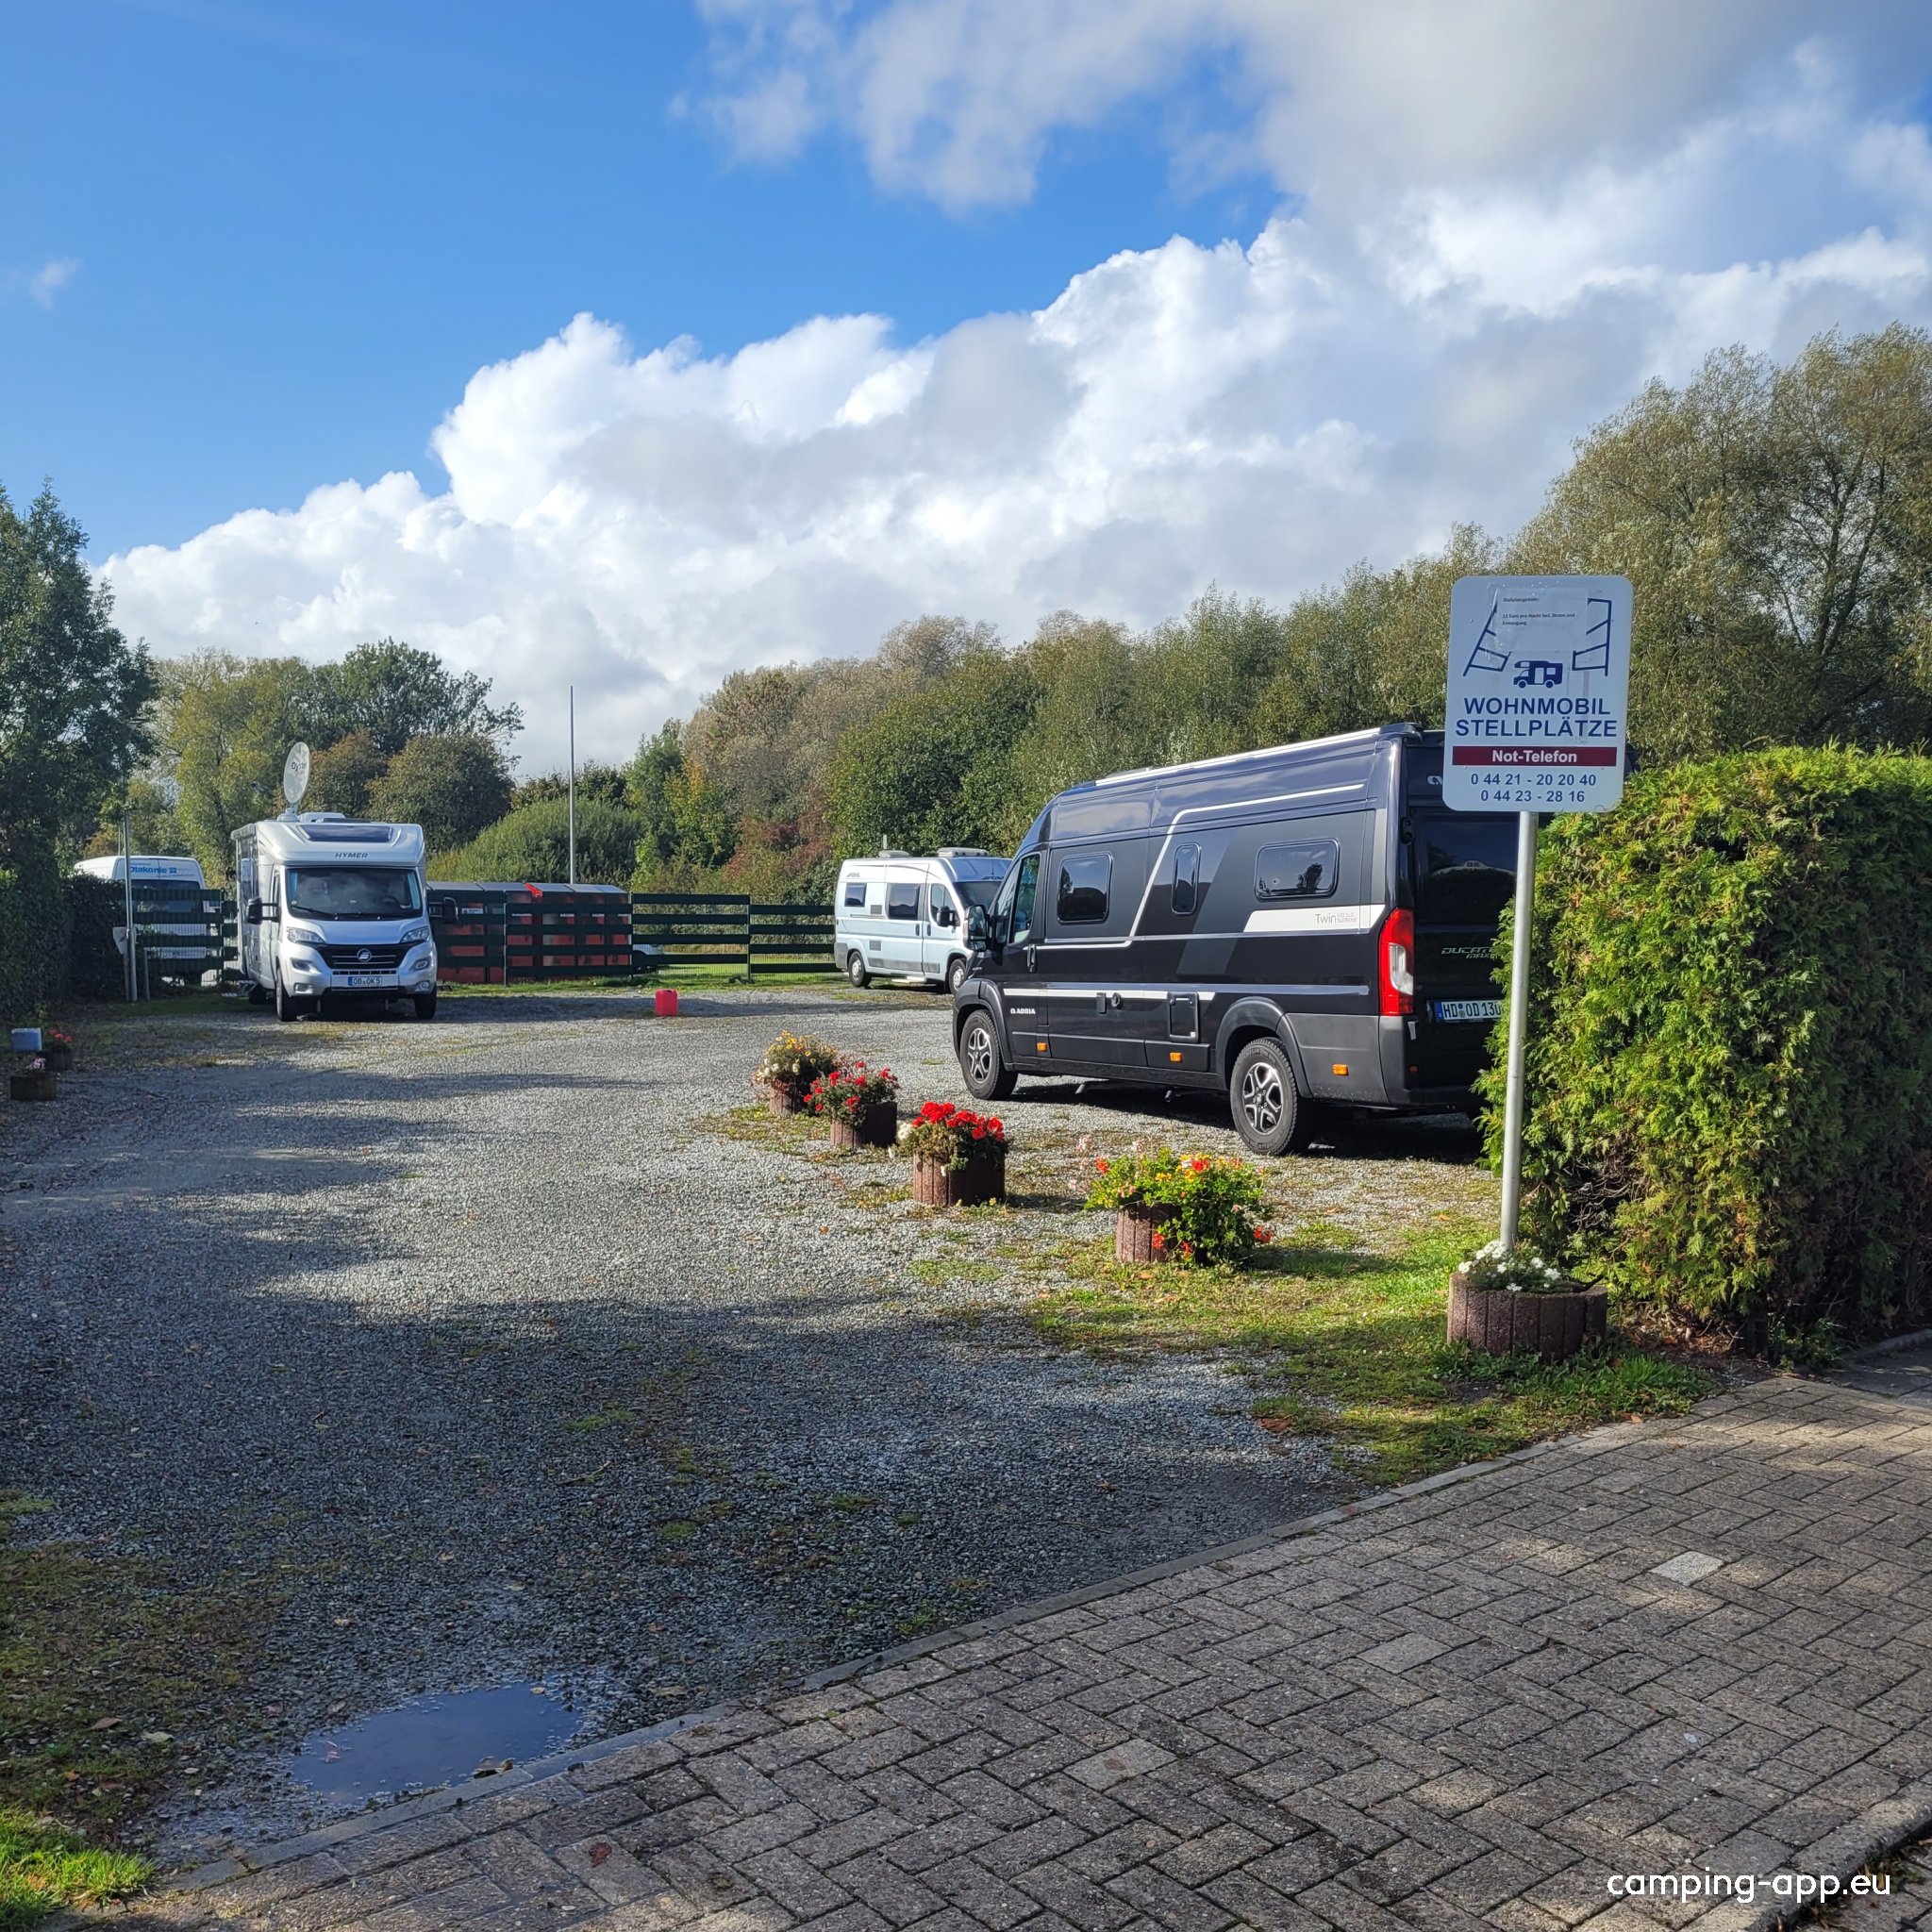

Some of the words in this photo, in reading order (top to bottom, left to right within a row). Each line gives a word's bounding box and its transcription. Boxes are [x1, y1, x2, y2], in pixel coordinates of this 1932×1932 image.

[1463, 697, 1611, 715] WOHNMOBIL
[1455, 716, 1618, 737] STELLPLÄTZE
[1491, 749, 1578, 763] Not-Telefon
[1471, 773, 1479, 785] 0
[1483, 773, 1501, 785] 44
[1505, 774, 1522, 785] 21
[1536, 774, 1554, 786] 20
[1557, 774, 1575, 786] 20
[1578, 774, 1597, 786] 40
[1480, 790, 1490, 802] 0
[1492, 790, 1511, 802] 44
[1515, 790, 1532, 802] 23
[1546, 790, 1563, 802] 28
[1568, 791, 1586, 803] 16
[1314, 913, 1337, 924] Twin
[1442, 1003, 1458, 1019] HD
[1465, 1003, 1480, 1017] OD
